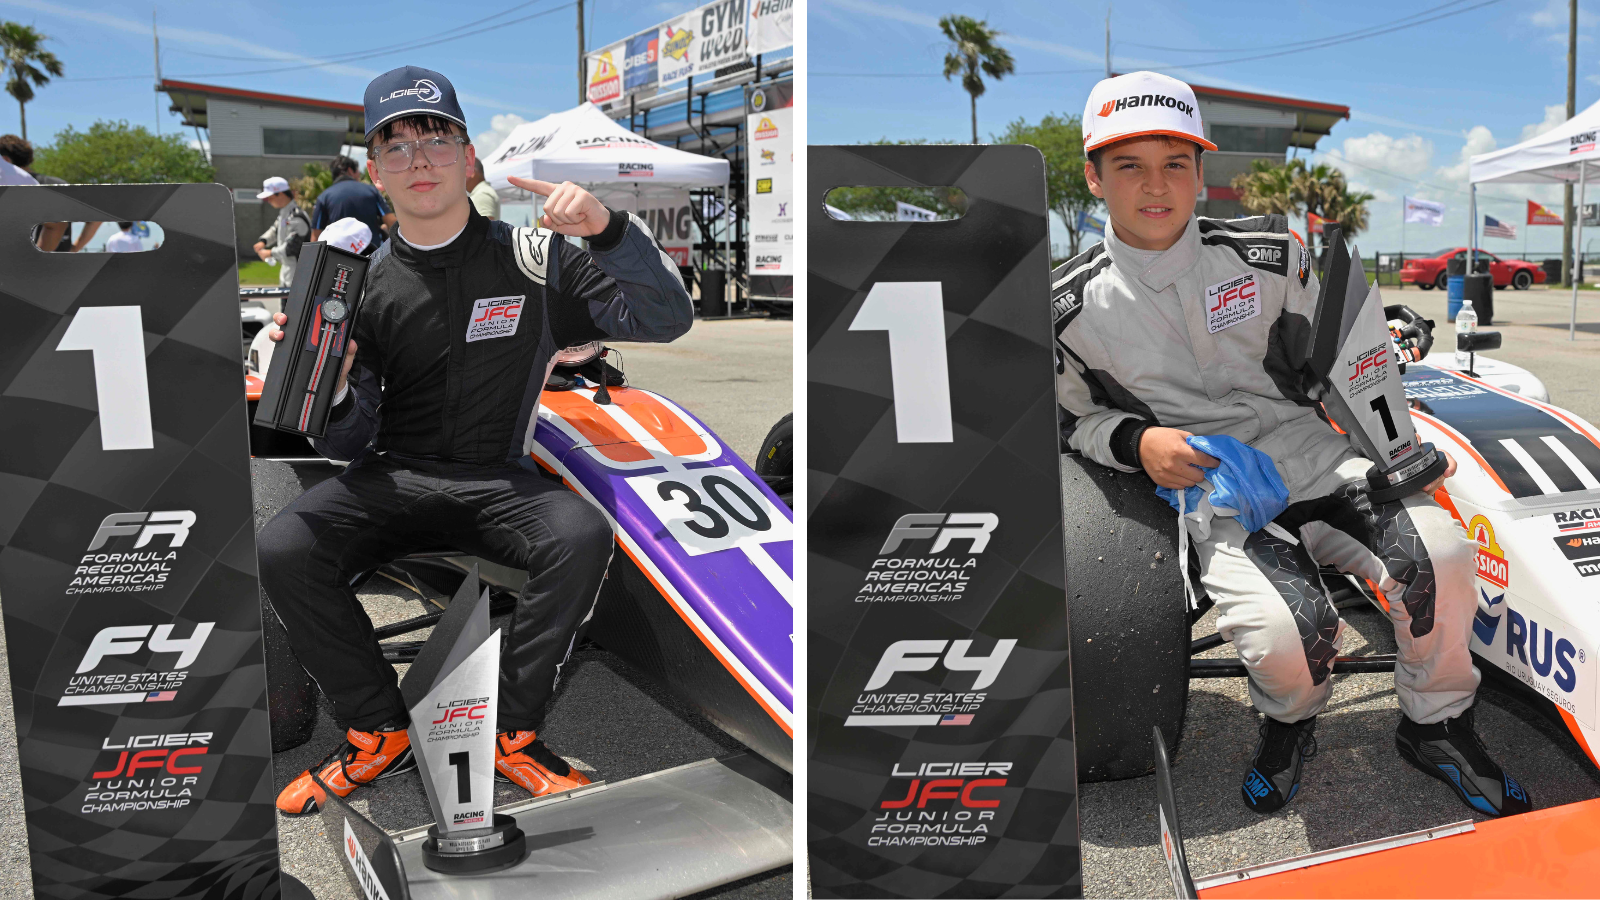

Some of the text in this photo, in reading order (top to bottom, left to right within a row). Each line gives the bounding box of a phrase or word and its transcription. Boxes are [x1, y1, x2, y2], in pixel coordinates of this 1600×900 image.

[702, 0, 745, 37] GYM
[380, 88, 431, 103] LIGIER
[1570, 131, 1596, 146] RACING
[618, 162, 654, 171] RACING
[756, 255, 782, 263] RACING
[1248, 248, 1281, 262] OMP
[1209, 274, 1253, 296] LIGIER
[478, 298, 522, 308] LIGIER
[1211, 281, 1255, 312] JFC
[475, 305, 520, 322] JFC
[1211, 298, 1254, 318] JUNIOR
[1211, 304, 1254, 325] FORMULA
[473, 319, 515, 328] JUNIOR
[1211, 310, 1255, 331] CHAMPIONSHIP
[470, 329, 512, 339] CHAMPIONSHIP
[471, 324, 513, 334] FORMULA
[1348, 342, 1386, 366] LIGIER
[848, 281, 954, 443] 1
[1349, 349, 1387, 381] JFC
[55, 305, 154, 451] 1
[1349, 364, 1387, 387] JUNIOR
[1349, 371, 1387, 392] FORMULA
[1370, 394, 1399, 442] 1
[1389, 440, 1411, 456] RACING
[657, 475, 772, 539] 30
[87, 510, 197, 552] FR
[878, 512, 1000, 555] FR
[81, 551, 177, 564] FORMULA
[871, 558, 977, 569] FORMULA
[75, 562, 172, 575] REGIONAL
[865, 570, 971, 581] REGIONAL
[69, 573, 169, 586] AMERICAS
[65, 584, 164, 595] CHAMPIONSHIP
[859, 582, 968, 593] AMERICAS
[854, 594, 962, 603] CHAMPIONSHIP
[75, 621, 216, 674] F4
[1507, 607, 1576, 693] RUS
[864, 638, 1018, 691] F4
[69, 671, 189, 686] UNITED STATES
[64, 681, 183, 695] CHAMPIONSHIP
[1517, 669, 1546, 694] URUGUAY
[1547, 687, 1576, 714] SEGUROS
[437, 697, 489, 709] LIGIER
[857, 692, 988, 704] UNITED STATES
[432, 704, 488, 724] JFC
[851, 703, 981, 714] CHAMPIONSHIP
[429, 727, 480, 736] FORMULA
[430, 720, 483, 731] JUNIOR
[101, 731, 213, 750] LIGIER
[427, 732, 479, 742] CHAMPIONSHIP
[92, 746, 209, 779] JFC
[891, 762, 1013, 777] LIGIER
[88, 776, 198, 791] JUNIOR
[449, 751, 471, 804] 1
[1245, 773, 1269, 797] OMP
[84, 788, 192, 802] FORMULA
[880, 778, 1008, 809] JFC
[81, 799, 190, 813] CHAMPIONSHIP
[454, 811, 484, 819] RACING
[875, 811, 995, 821] JUNIOR
[871, 823, 989, 834] FORMULA
[868, 836, 986, 846] CHAMPIONSHIP
